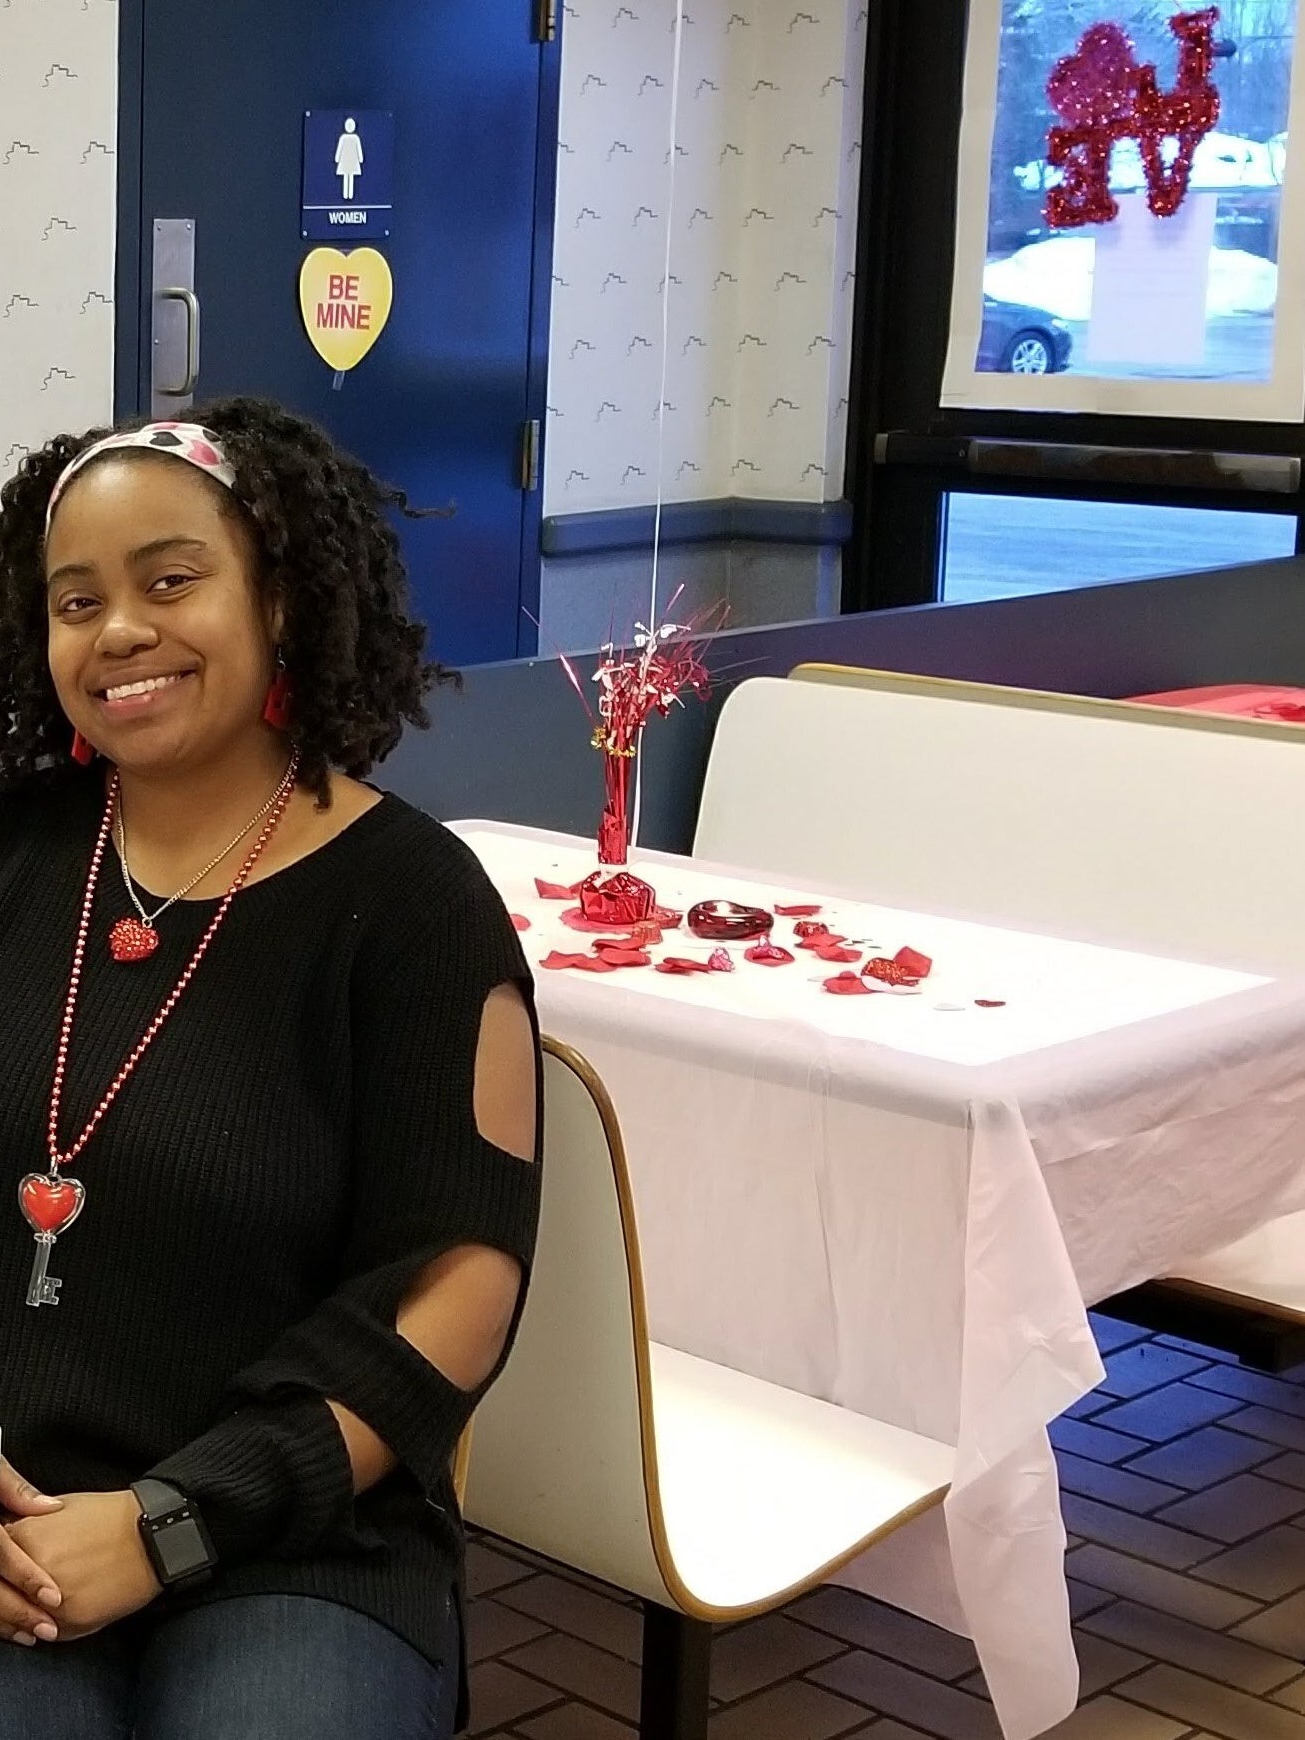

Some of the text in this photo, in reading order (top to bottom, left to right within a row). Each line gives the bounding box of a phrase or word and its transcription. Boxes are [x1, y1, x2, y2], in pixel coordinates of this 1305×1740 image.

[328, 211, 367, 225] WOMEN
[328, 274, 360, 301] BE
[316, 302, 372, 331] MINE
